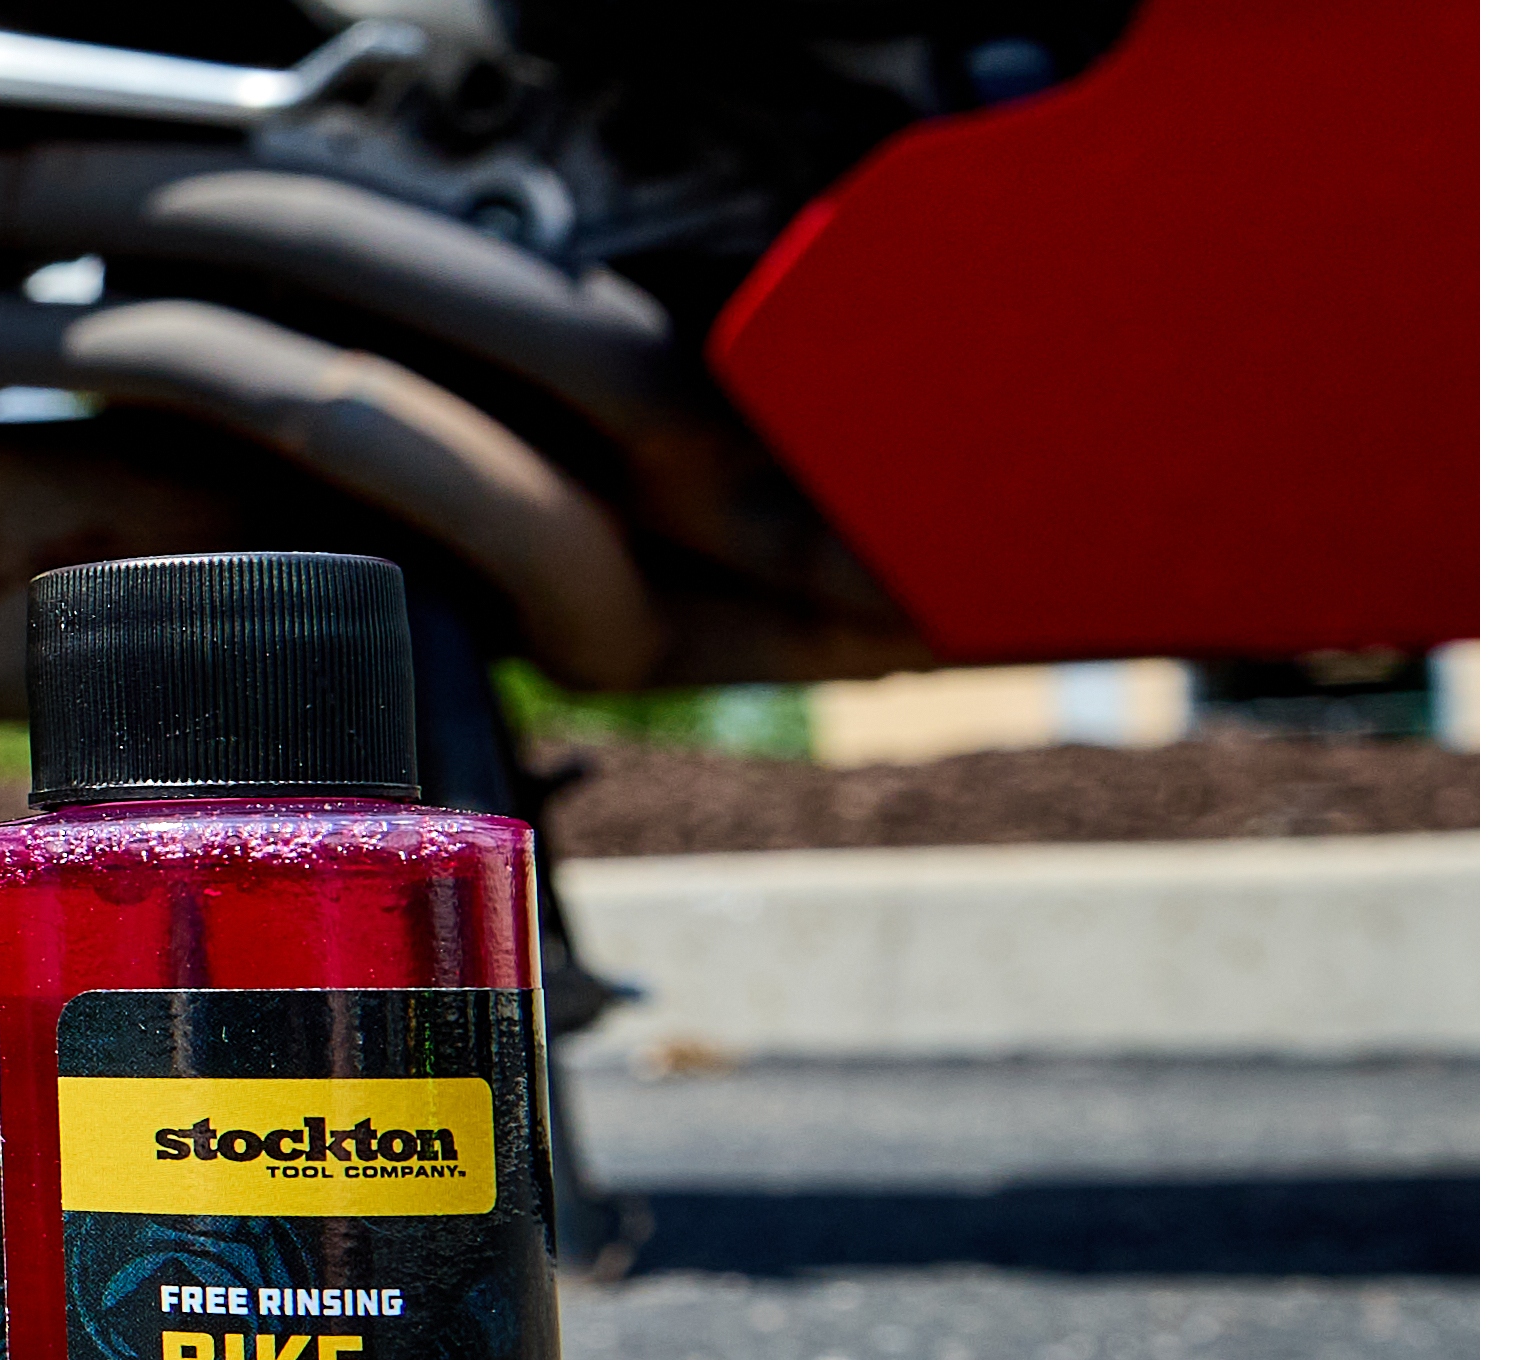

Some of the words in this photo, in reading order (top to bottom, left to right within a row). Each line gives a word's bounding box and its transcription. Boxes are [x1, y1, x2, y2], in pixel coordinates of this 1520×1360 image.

[156, 1117, 458, 1162] stockton
[266, 1165, 334, 1179] TOOL
[161, 1285, 248, 1315] FREE
[259, 1288, 404, 1316] RINSING
